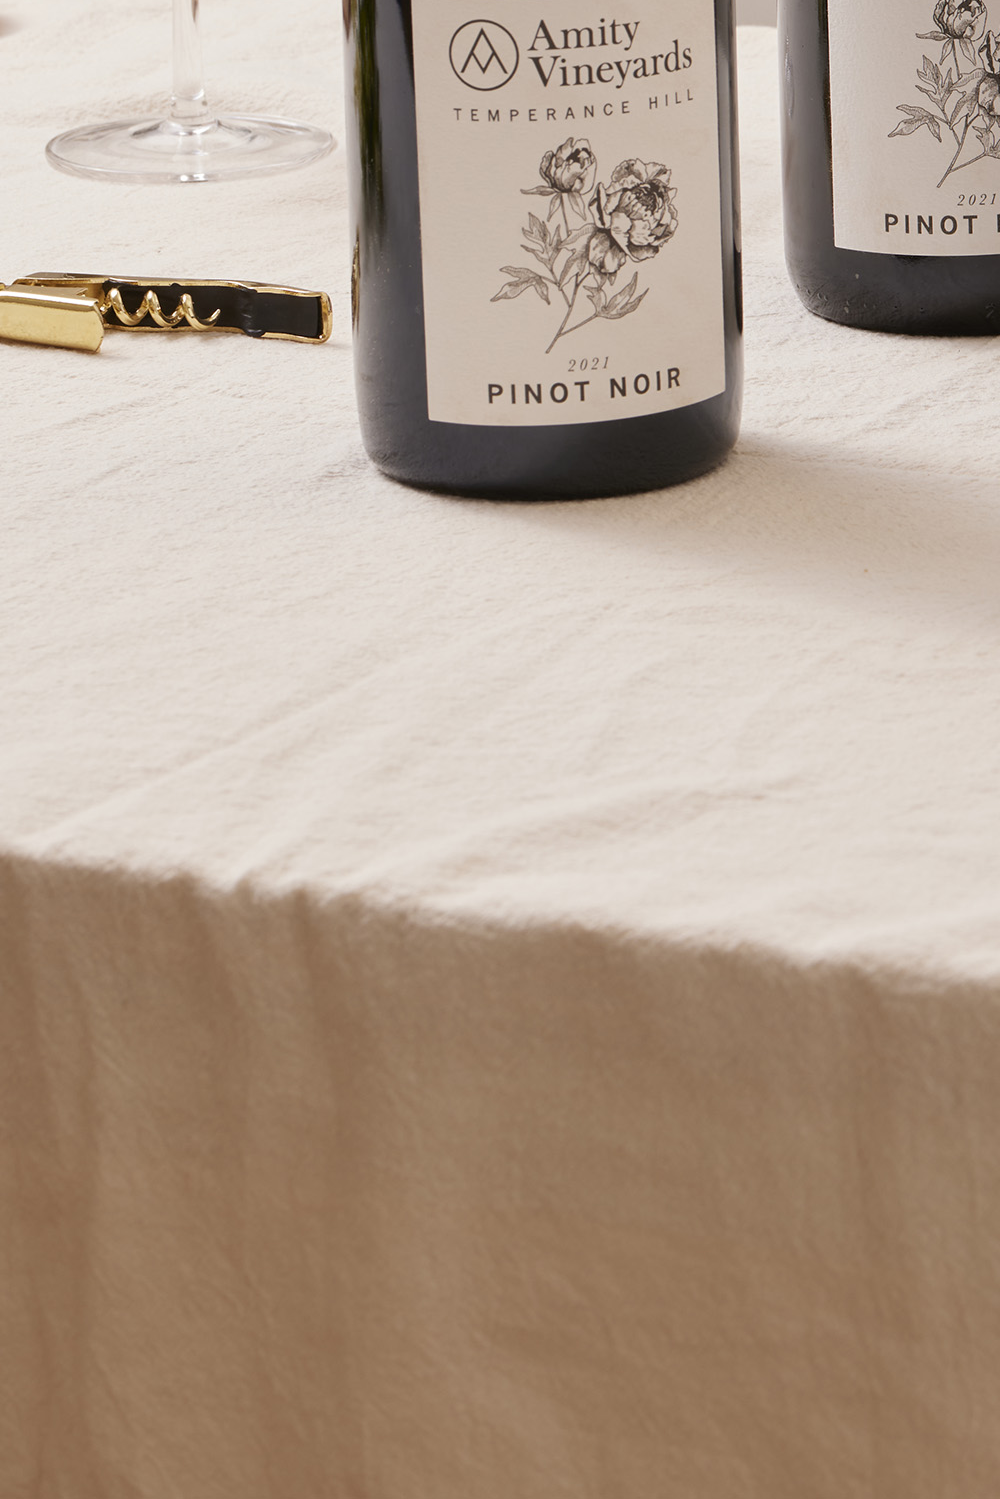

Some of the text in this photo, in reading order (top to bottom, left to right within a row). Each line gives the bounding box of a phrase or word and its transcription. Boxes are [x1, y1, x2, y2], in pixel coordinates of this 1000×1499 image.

[527, 18, 640, 51] Amity
[528, 39, 692, 89] Vineyards
[453, 89, 693, 121] TEMPERANCE HILL
[957, 194, 996, 206] 2021
[885, 213, 978, 235] PINOT
[568, 357, 608, 372] 2021
[488, 367, 680, 404] PINOT NOIR
